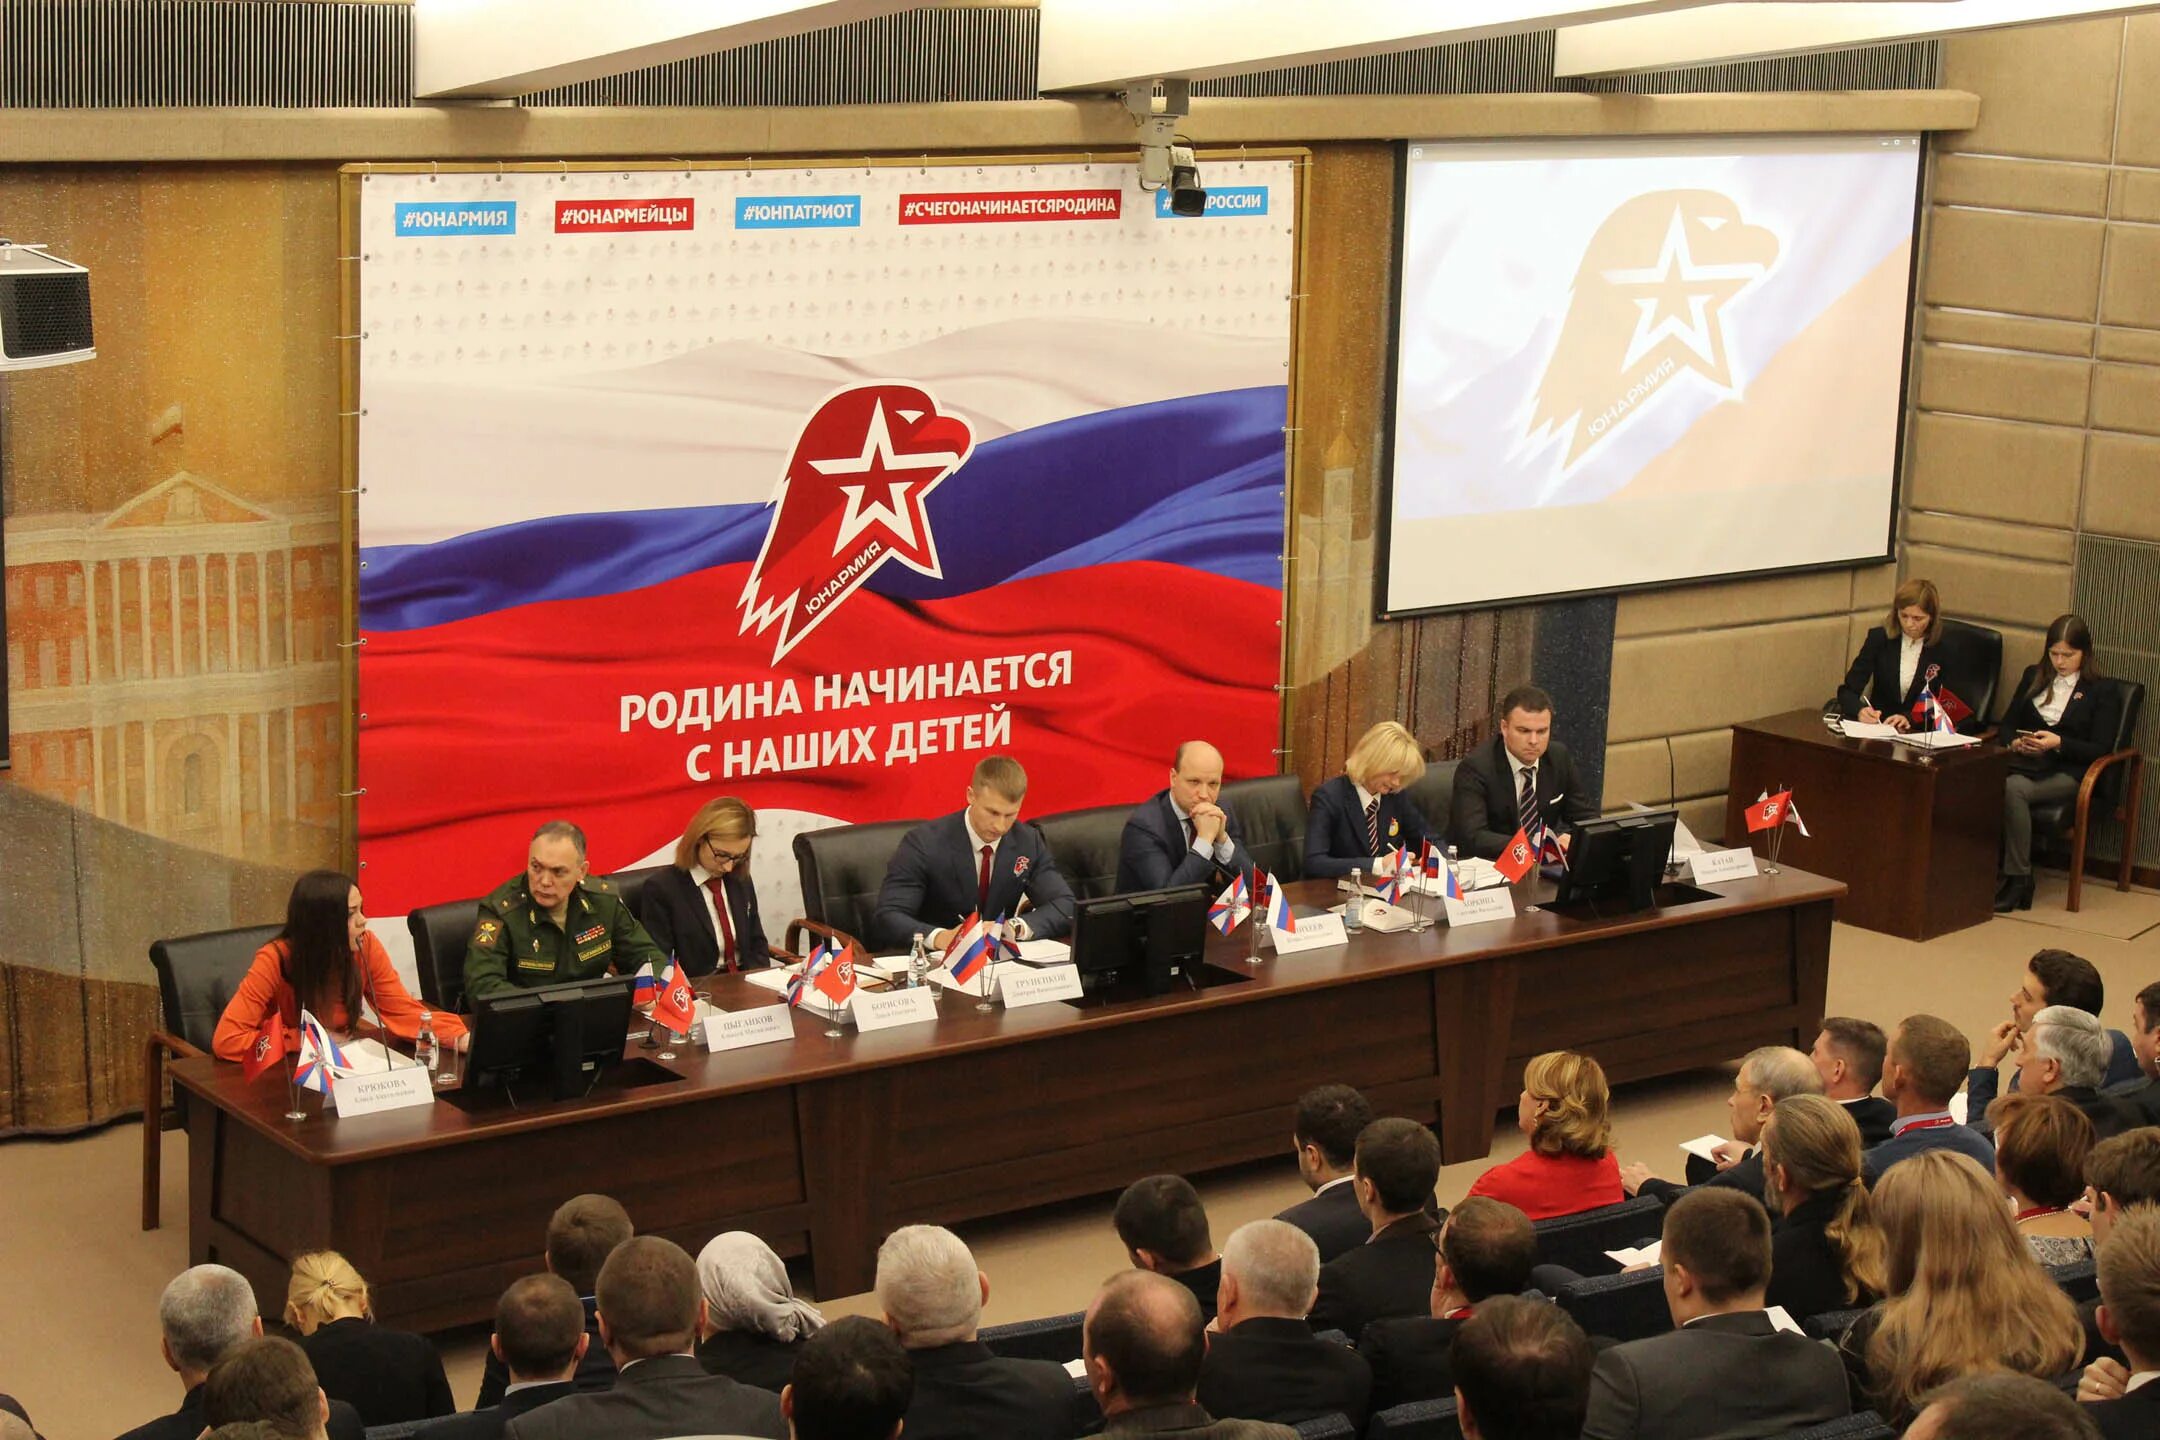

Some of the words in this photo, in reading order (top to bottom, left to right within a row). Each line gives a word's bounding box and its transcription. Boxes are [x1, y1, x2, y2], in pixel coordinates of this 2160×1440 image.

[560, 204, 688, 225] #ЮНАРМЕЙЦЫ
[743, 203, 855, 221] #ЮНПАТРИОТ
[904, 197, 1116, 217] #СЧЕГОНАЧИНАЕТСЯРОДИНА
[402, 210, 508, 228] #ЮНАРМИЯ
[1587, 357, 1675, 437] ЮНАРМИЯ
[805, 540, 881, 615] ЮНАРМИЯ
[620, 678, 803, 734] РОДИНА
[814, 650, 1073, 712] НАЧИНАЕТСЯ
[686, 744, 711, 782] С
[723, 725, 877, 778] НАШИХ
[885, 702, 1011, 767] ДЕТЕЙ
[357, 1079, 408, 1094] КРЮКОВА
